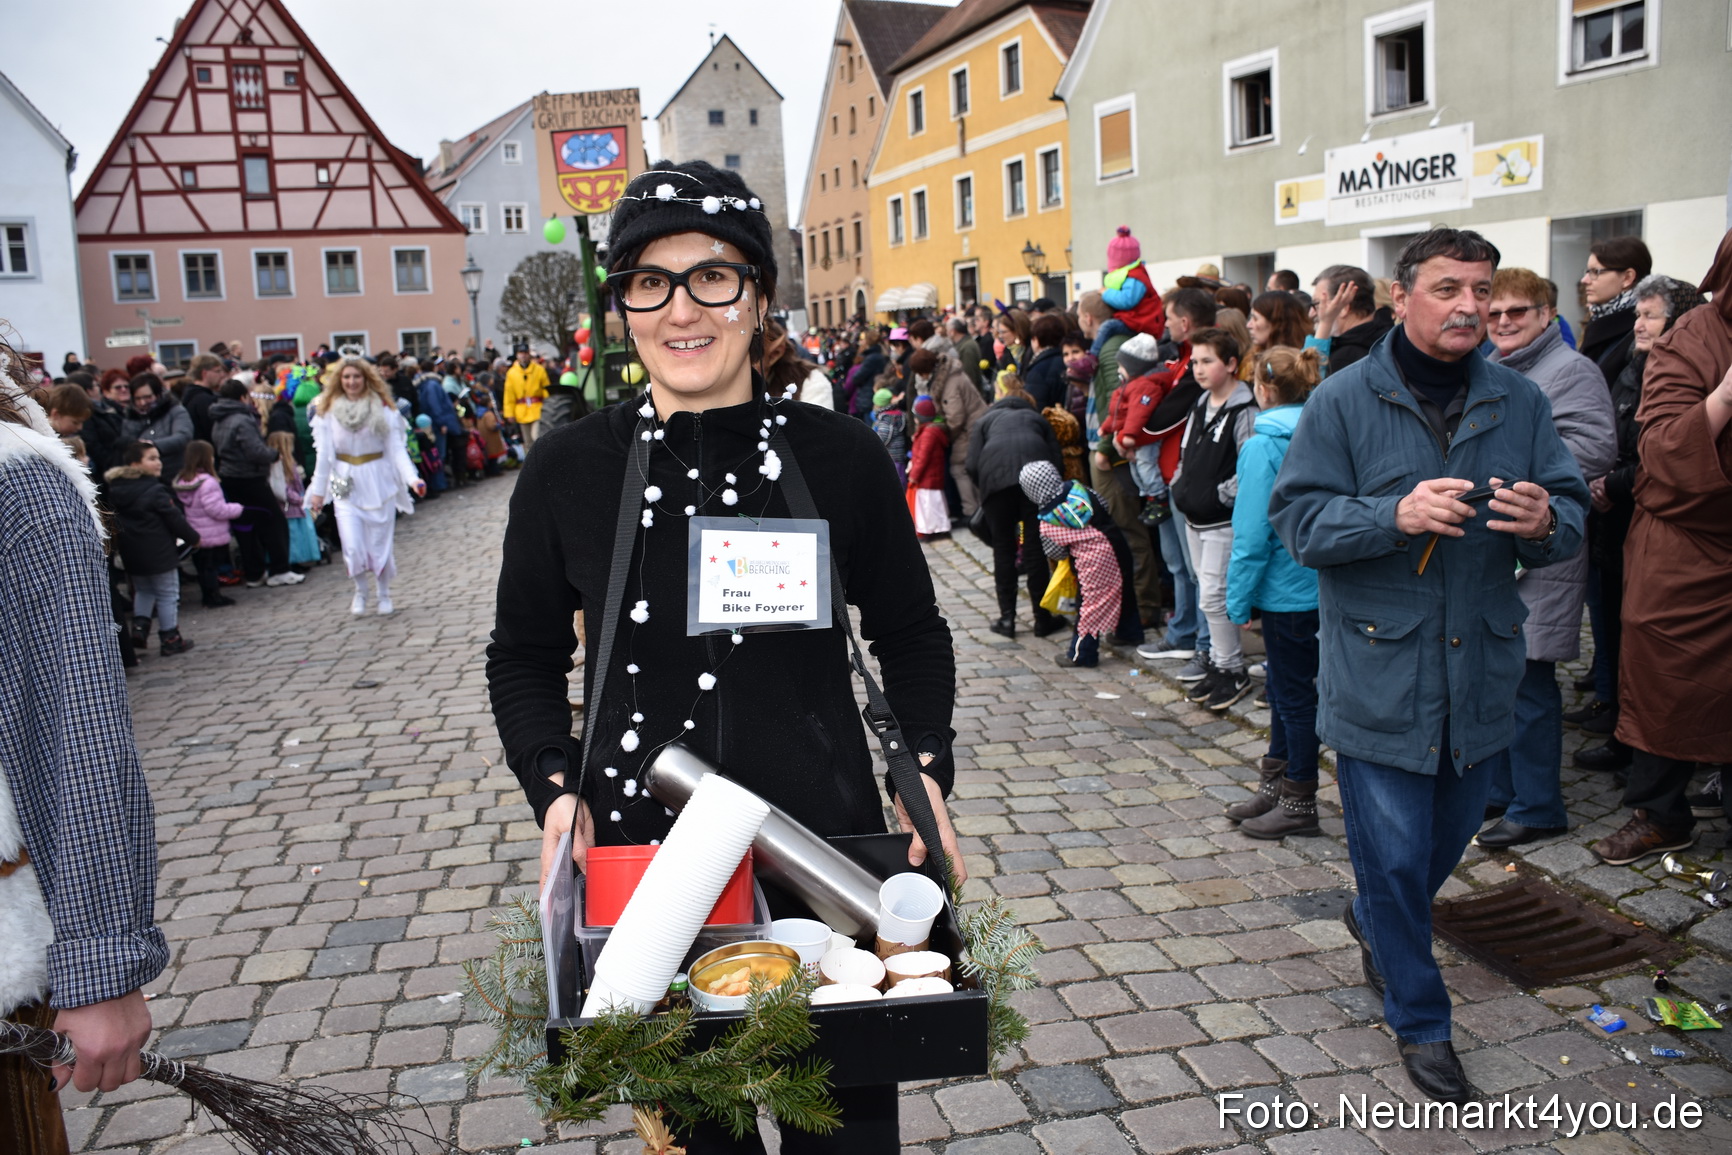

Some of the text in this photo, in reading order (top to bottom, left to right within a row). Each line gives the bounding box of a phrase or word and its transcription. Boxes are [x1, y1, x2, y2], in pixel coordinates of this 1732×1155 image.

[1338, 152, 1456, 194] MAYINGER
[1354, 187, 1437, 208] BESTATTUNGEN
[749, 564, 790, 575] BERCHING
[722, 588, 751, 598] Frau
[722, 603, 805, 613] Bike Foyerer
